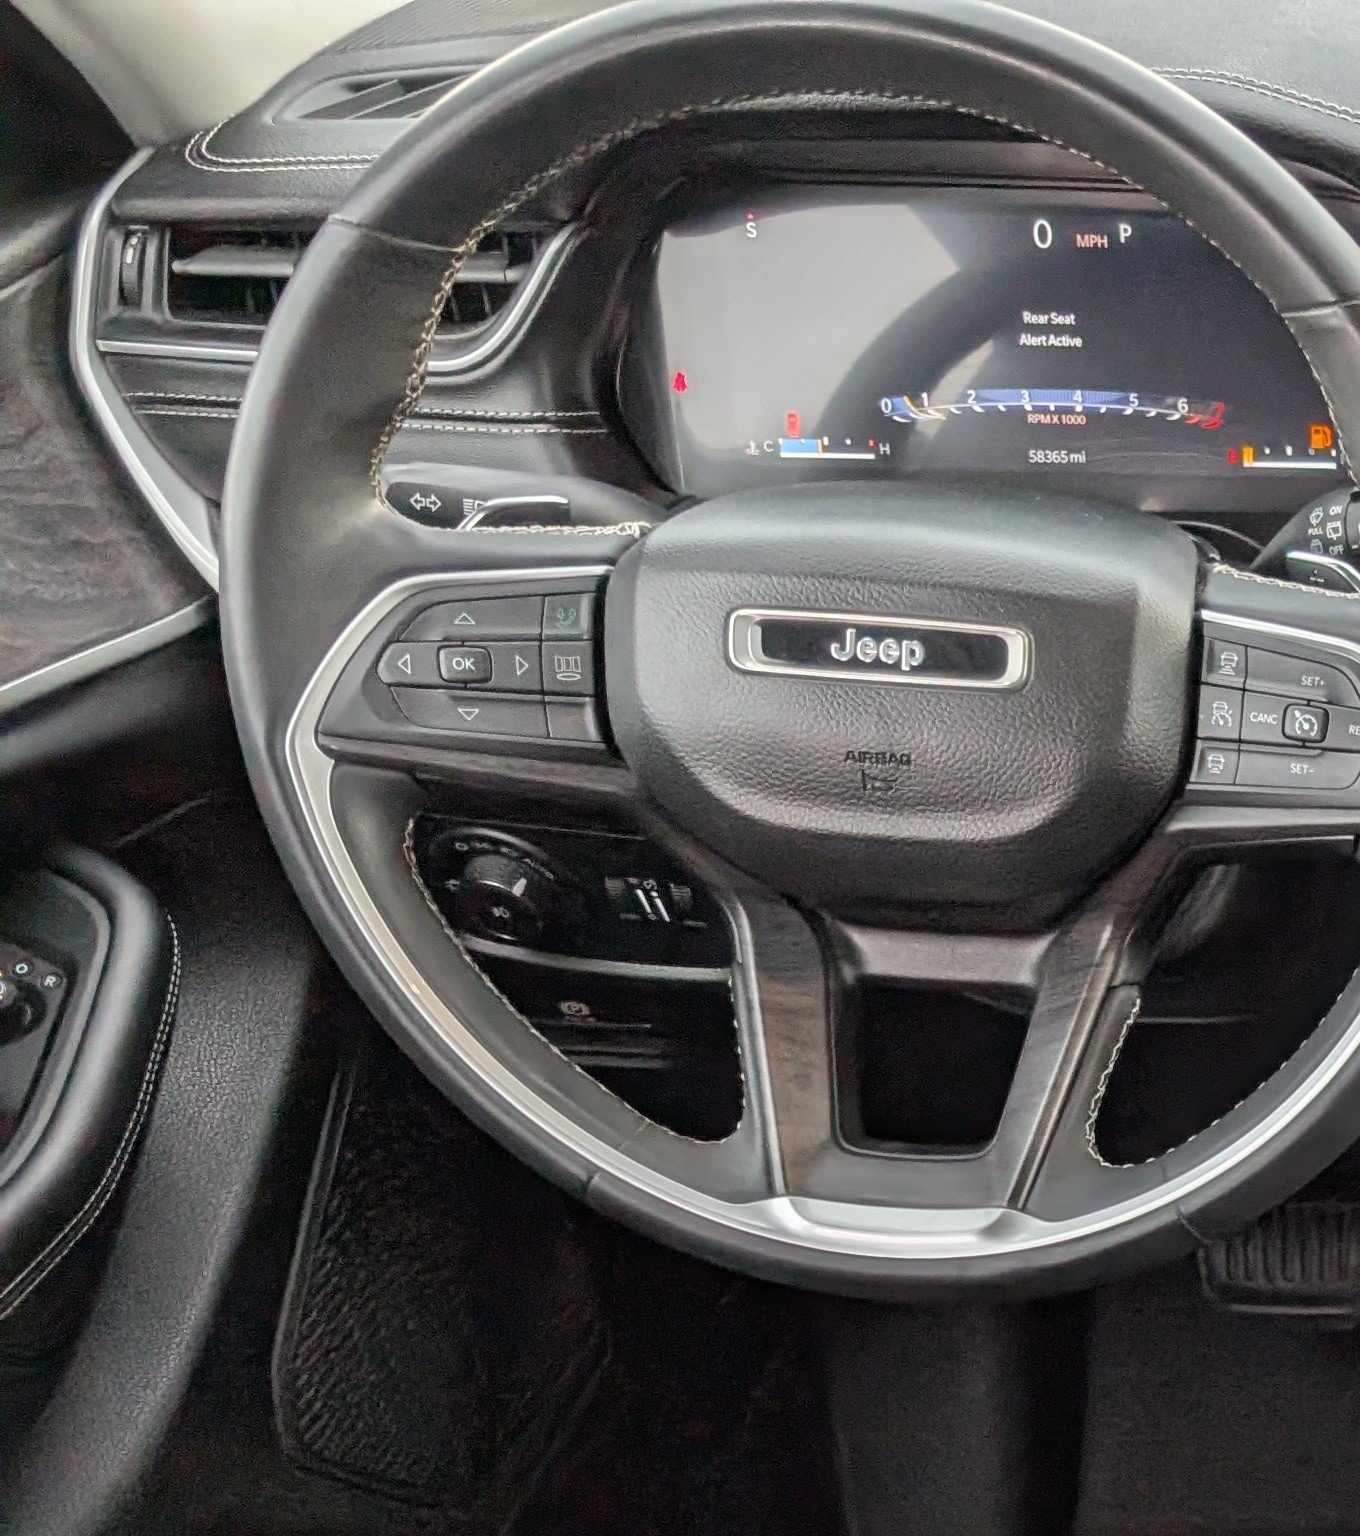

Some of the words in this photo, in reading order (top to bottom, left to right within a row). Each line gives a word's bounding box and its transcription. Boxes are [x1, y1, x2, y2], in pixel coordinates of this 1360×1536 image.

[746, 222, 757, 238] S
[1033, 219, 1052, 249] 0
[1075, 233, 1108, 248] MPH
[1118, 222, 1132, 243] P
[1022, 311, 1049, 324] Rear
[1050, 311, 1076, 325] Seat
[1019, 333, 1047, 346] Alert
[1048, 334, 1082, 347] Active
[921, 392, 928, 407] 1
[967, 389, 976, 404] 2
[1020, 389, 1030, 403] 3
[1073, 390, 1082, 402] 4
[1129, 393, 1138, 408] 5
[881, 397, 892, 414] 0
[1178, 398, 1188, 413] 6
[1027, 413, 1051, 424] RPM
[1062, 414, 1086, 425] 1000
[764, 440, 774, 452] C
[879, 443, 890, 455] H
[1028, 450, 1068, 464] 58365
[1070, 451, 1086, 463] mi
[1329, 505, 1343, 516] ON
[1329, 545, 1344, 556] OFF
[830, 628, 925, 671] Jeep
[452, 657, 475, 672] OK
[1301, 675, 1325, 687] SET+
[1250, 712, 1278, 725] CANC
[844, 750, 912, 766] AIRBAG
[44, 975, 56, 987] R
